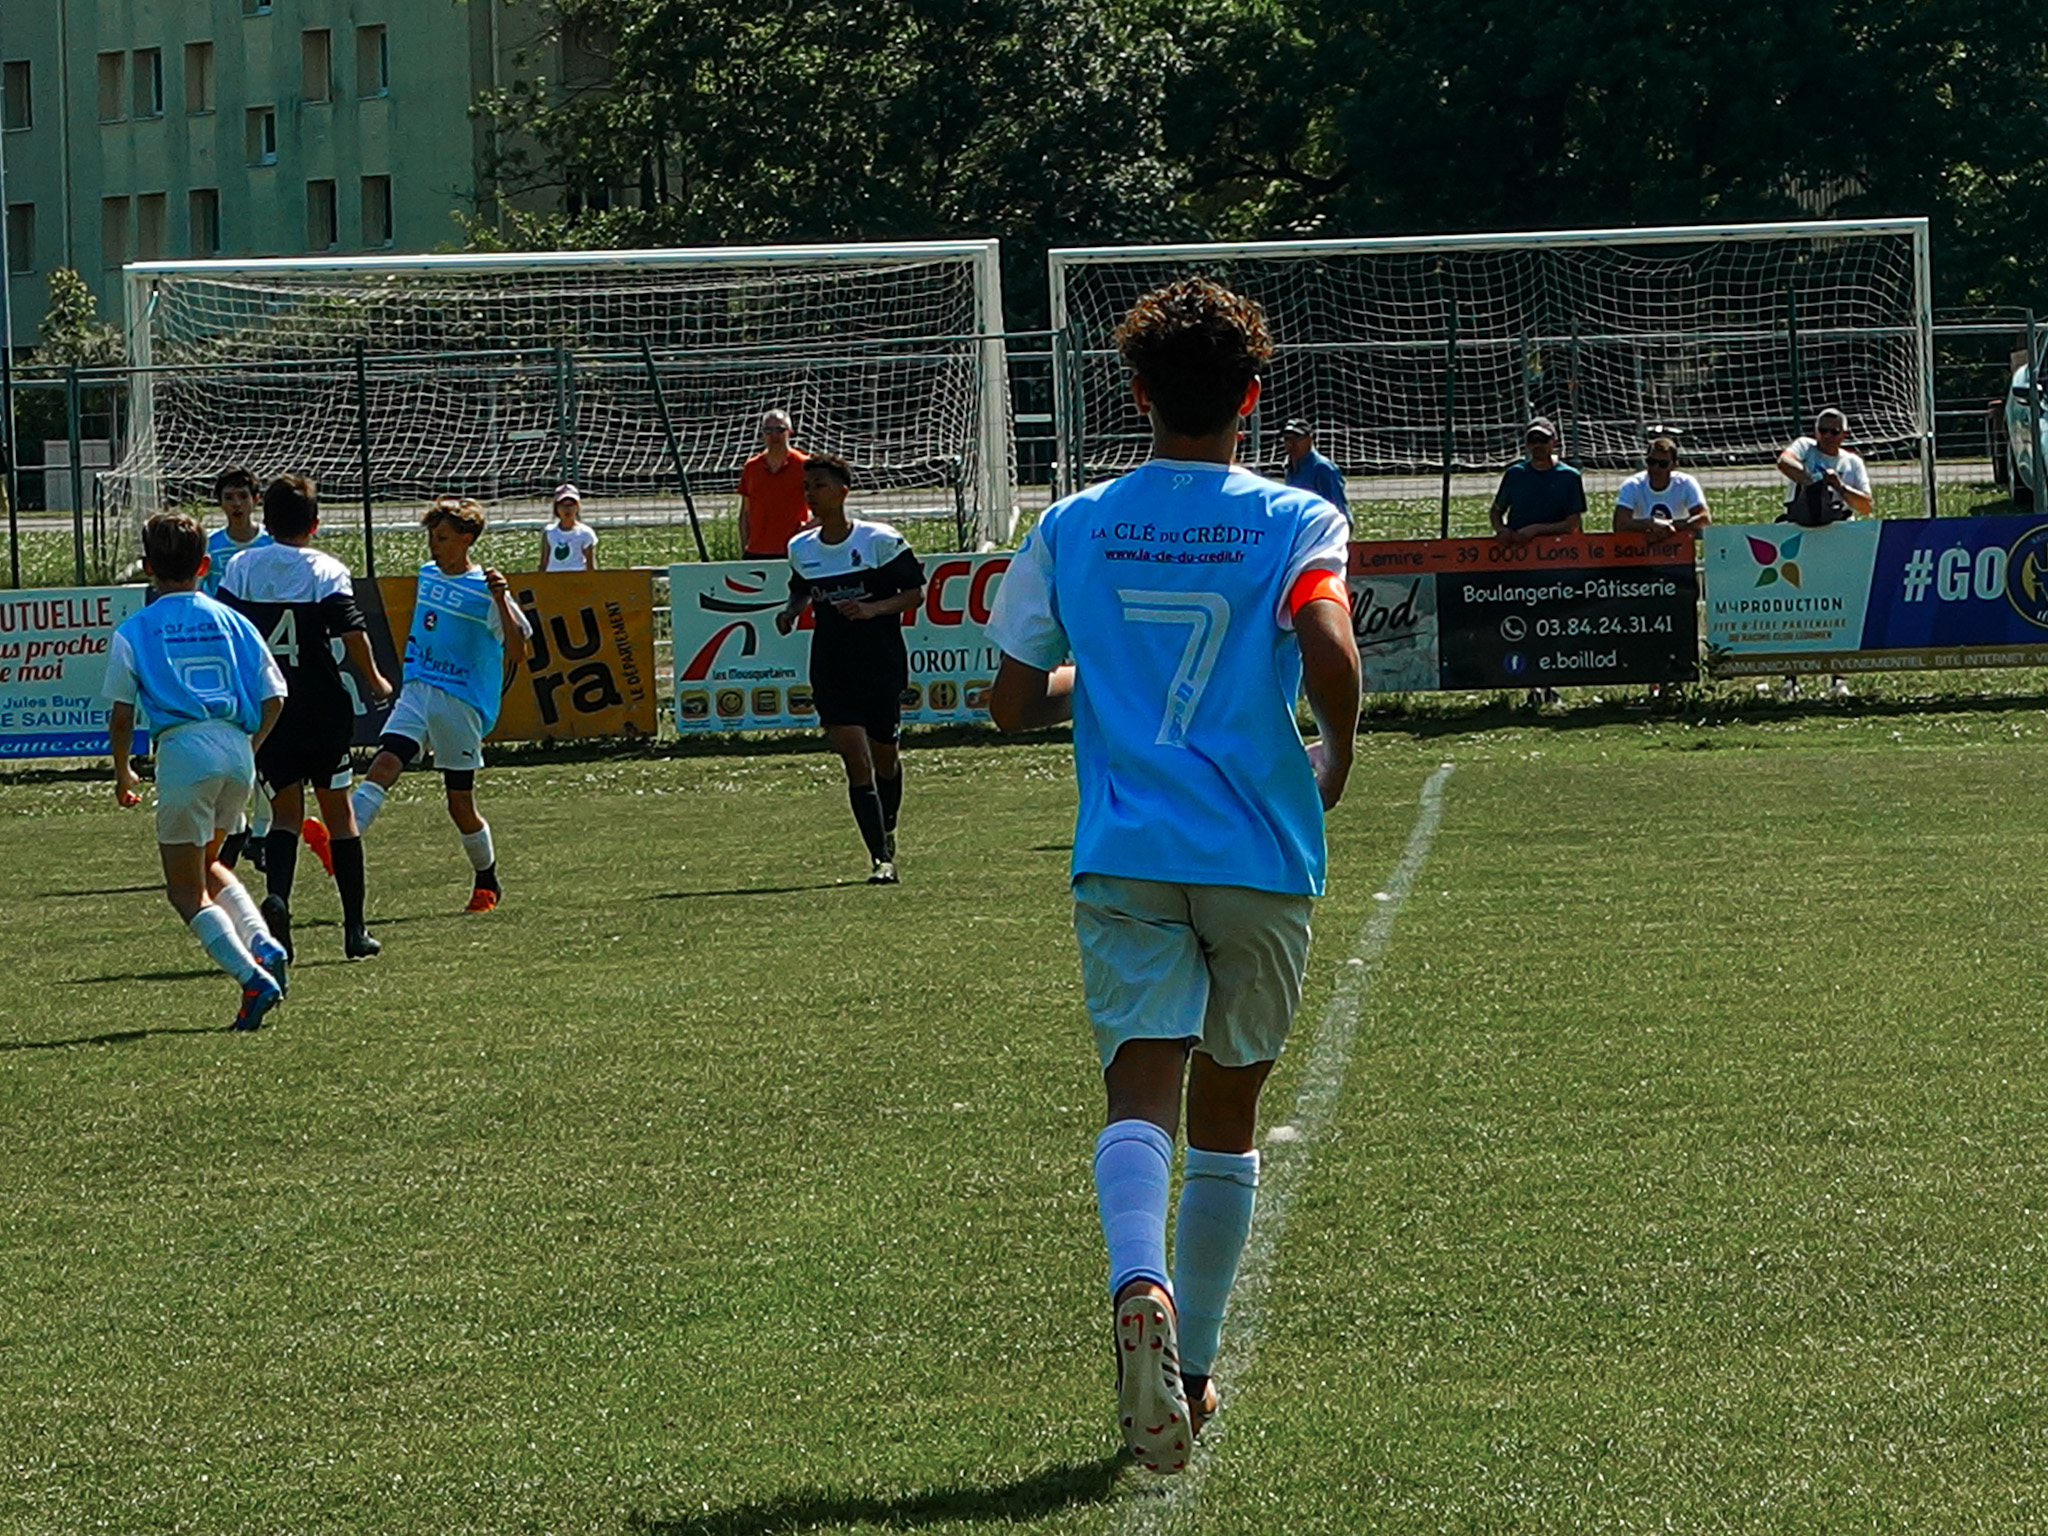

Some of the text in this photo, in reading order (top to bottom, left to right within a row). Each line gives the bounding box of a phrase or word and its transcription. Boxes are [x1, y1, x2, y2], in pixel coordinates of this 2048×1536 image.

[1091, 522, 1265, 545] LA CLÉ DU CRÉDIT
[1456, 547, 1480, 563] 39
[1488, 546, 1528, 562] 000
[1537, 544, 1578, 561] Lons
[1588, 541, 1605, 559] le
[1463, 578, 1677, 607] Boulangerie-Pâtisserie
[1536, 615, 1673, 637] 03.84.24.31.41
[25, 633, 108, 664] proche
[267, 609, 299, 667] 4
[18, 659, 63, 683] moi
[1115, 589, 1231, 749] 7
[1539, 650, 1618, 670] e.boillod
[3, 695, 92, 709] Jules Bury
[22, 709, 112, 727] SAUNIE
